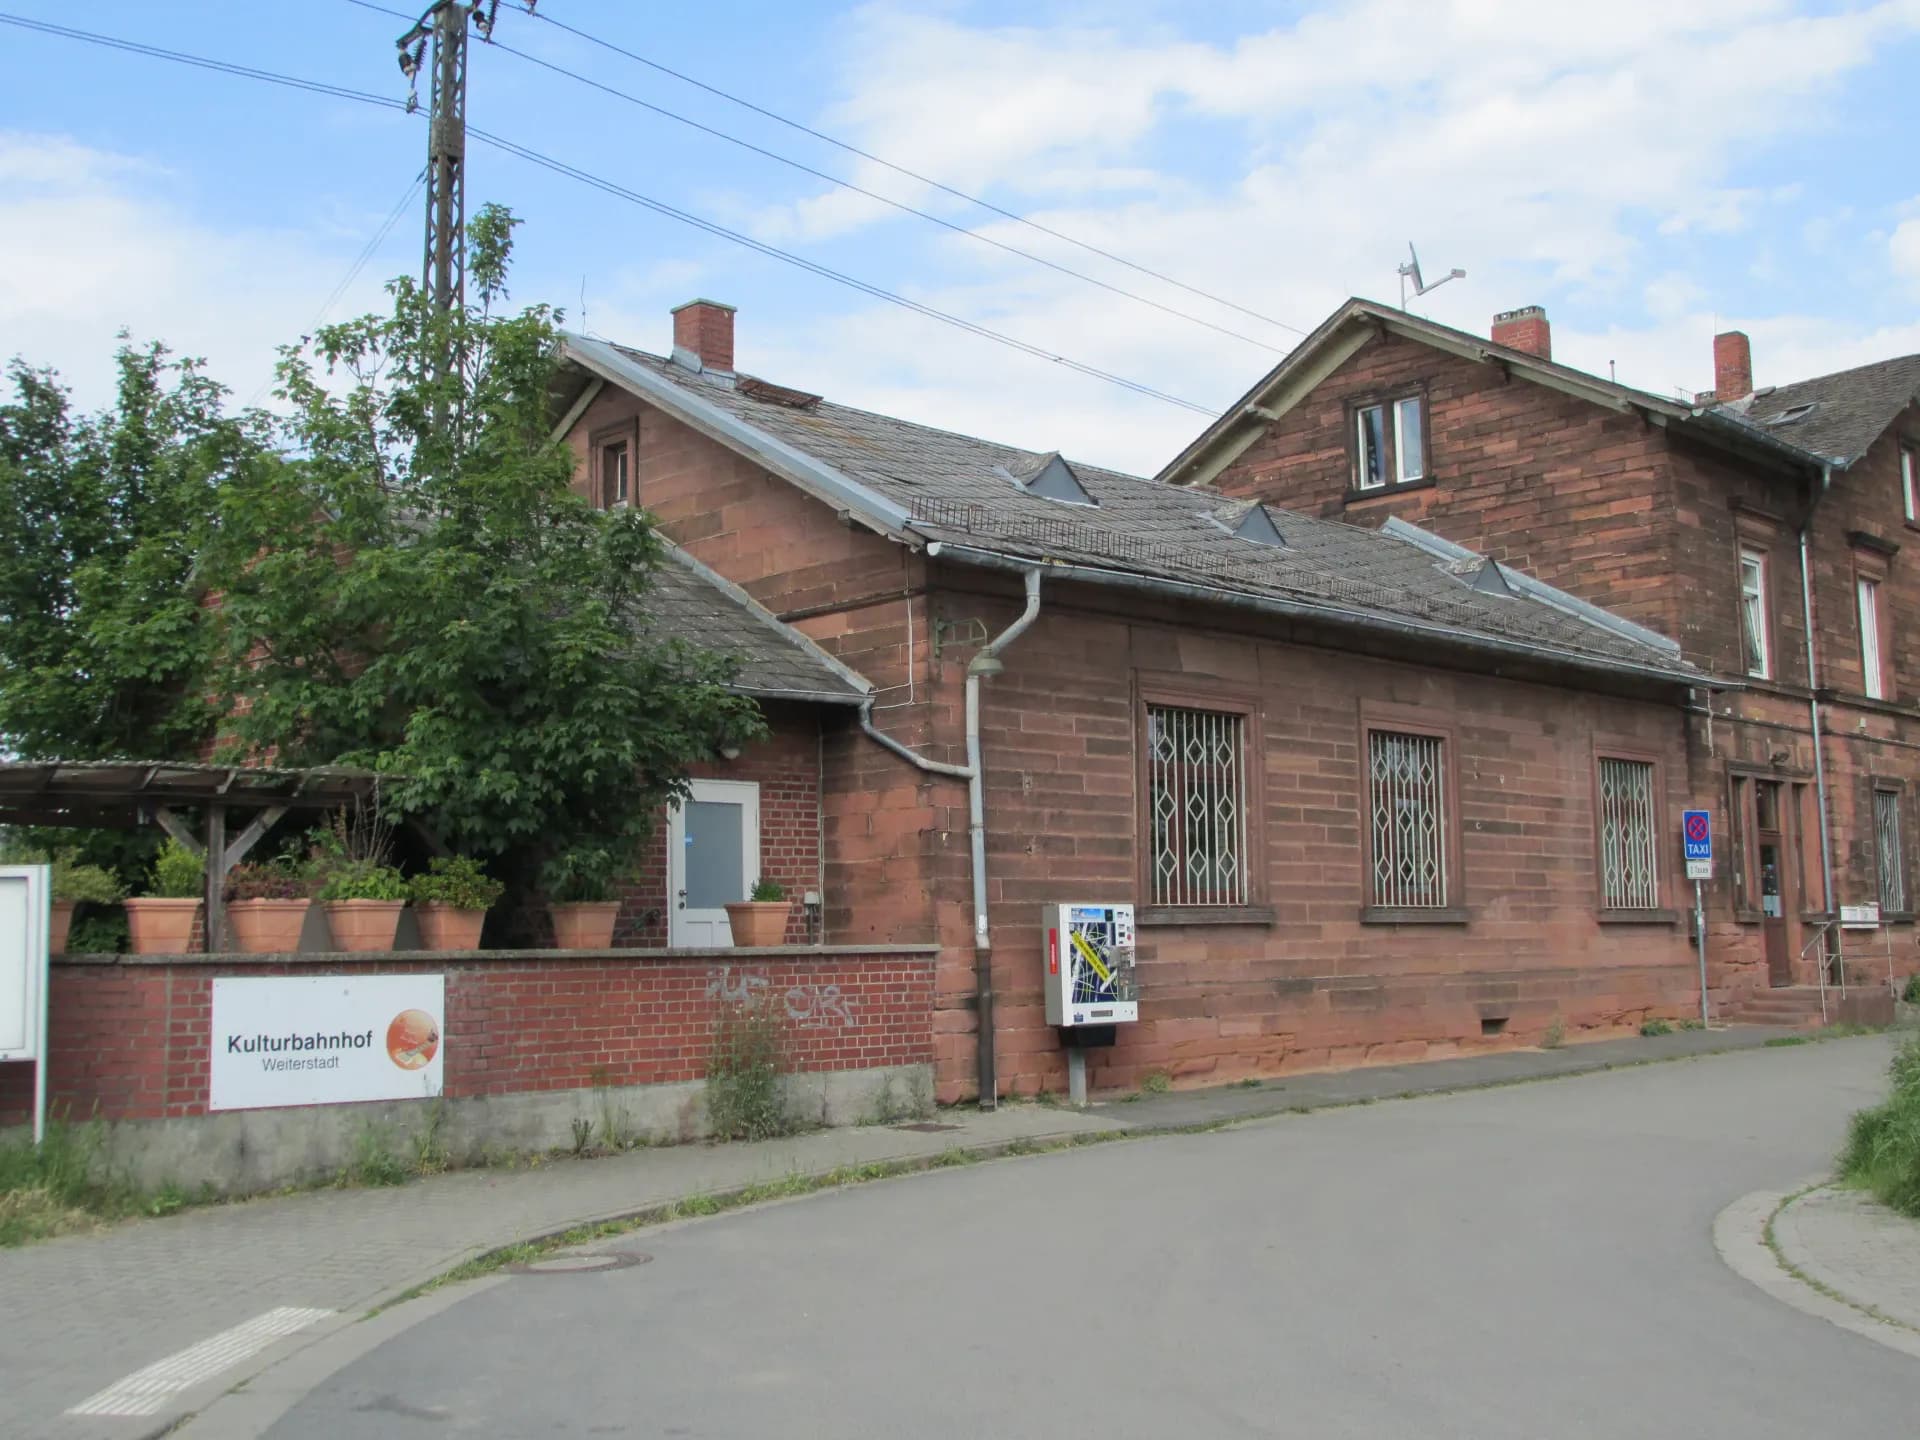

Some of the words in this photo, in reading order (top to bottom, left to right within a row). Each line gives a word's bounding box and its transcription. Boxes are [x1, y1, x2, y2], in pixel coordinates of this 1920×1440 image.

[1688, 844, 1709, 855] TAXI
[228, 1030, 373, 1053] Kulturbahnhof
[262, 1056, 339, 1071] Weiterstadt
